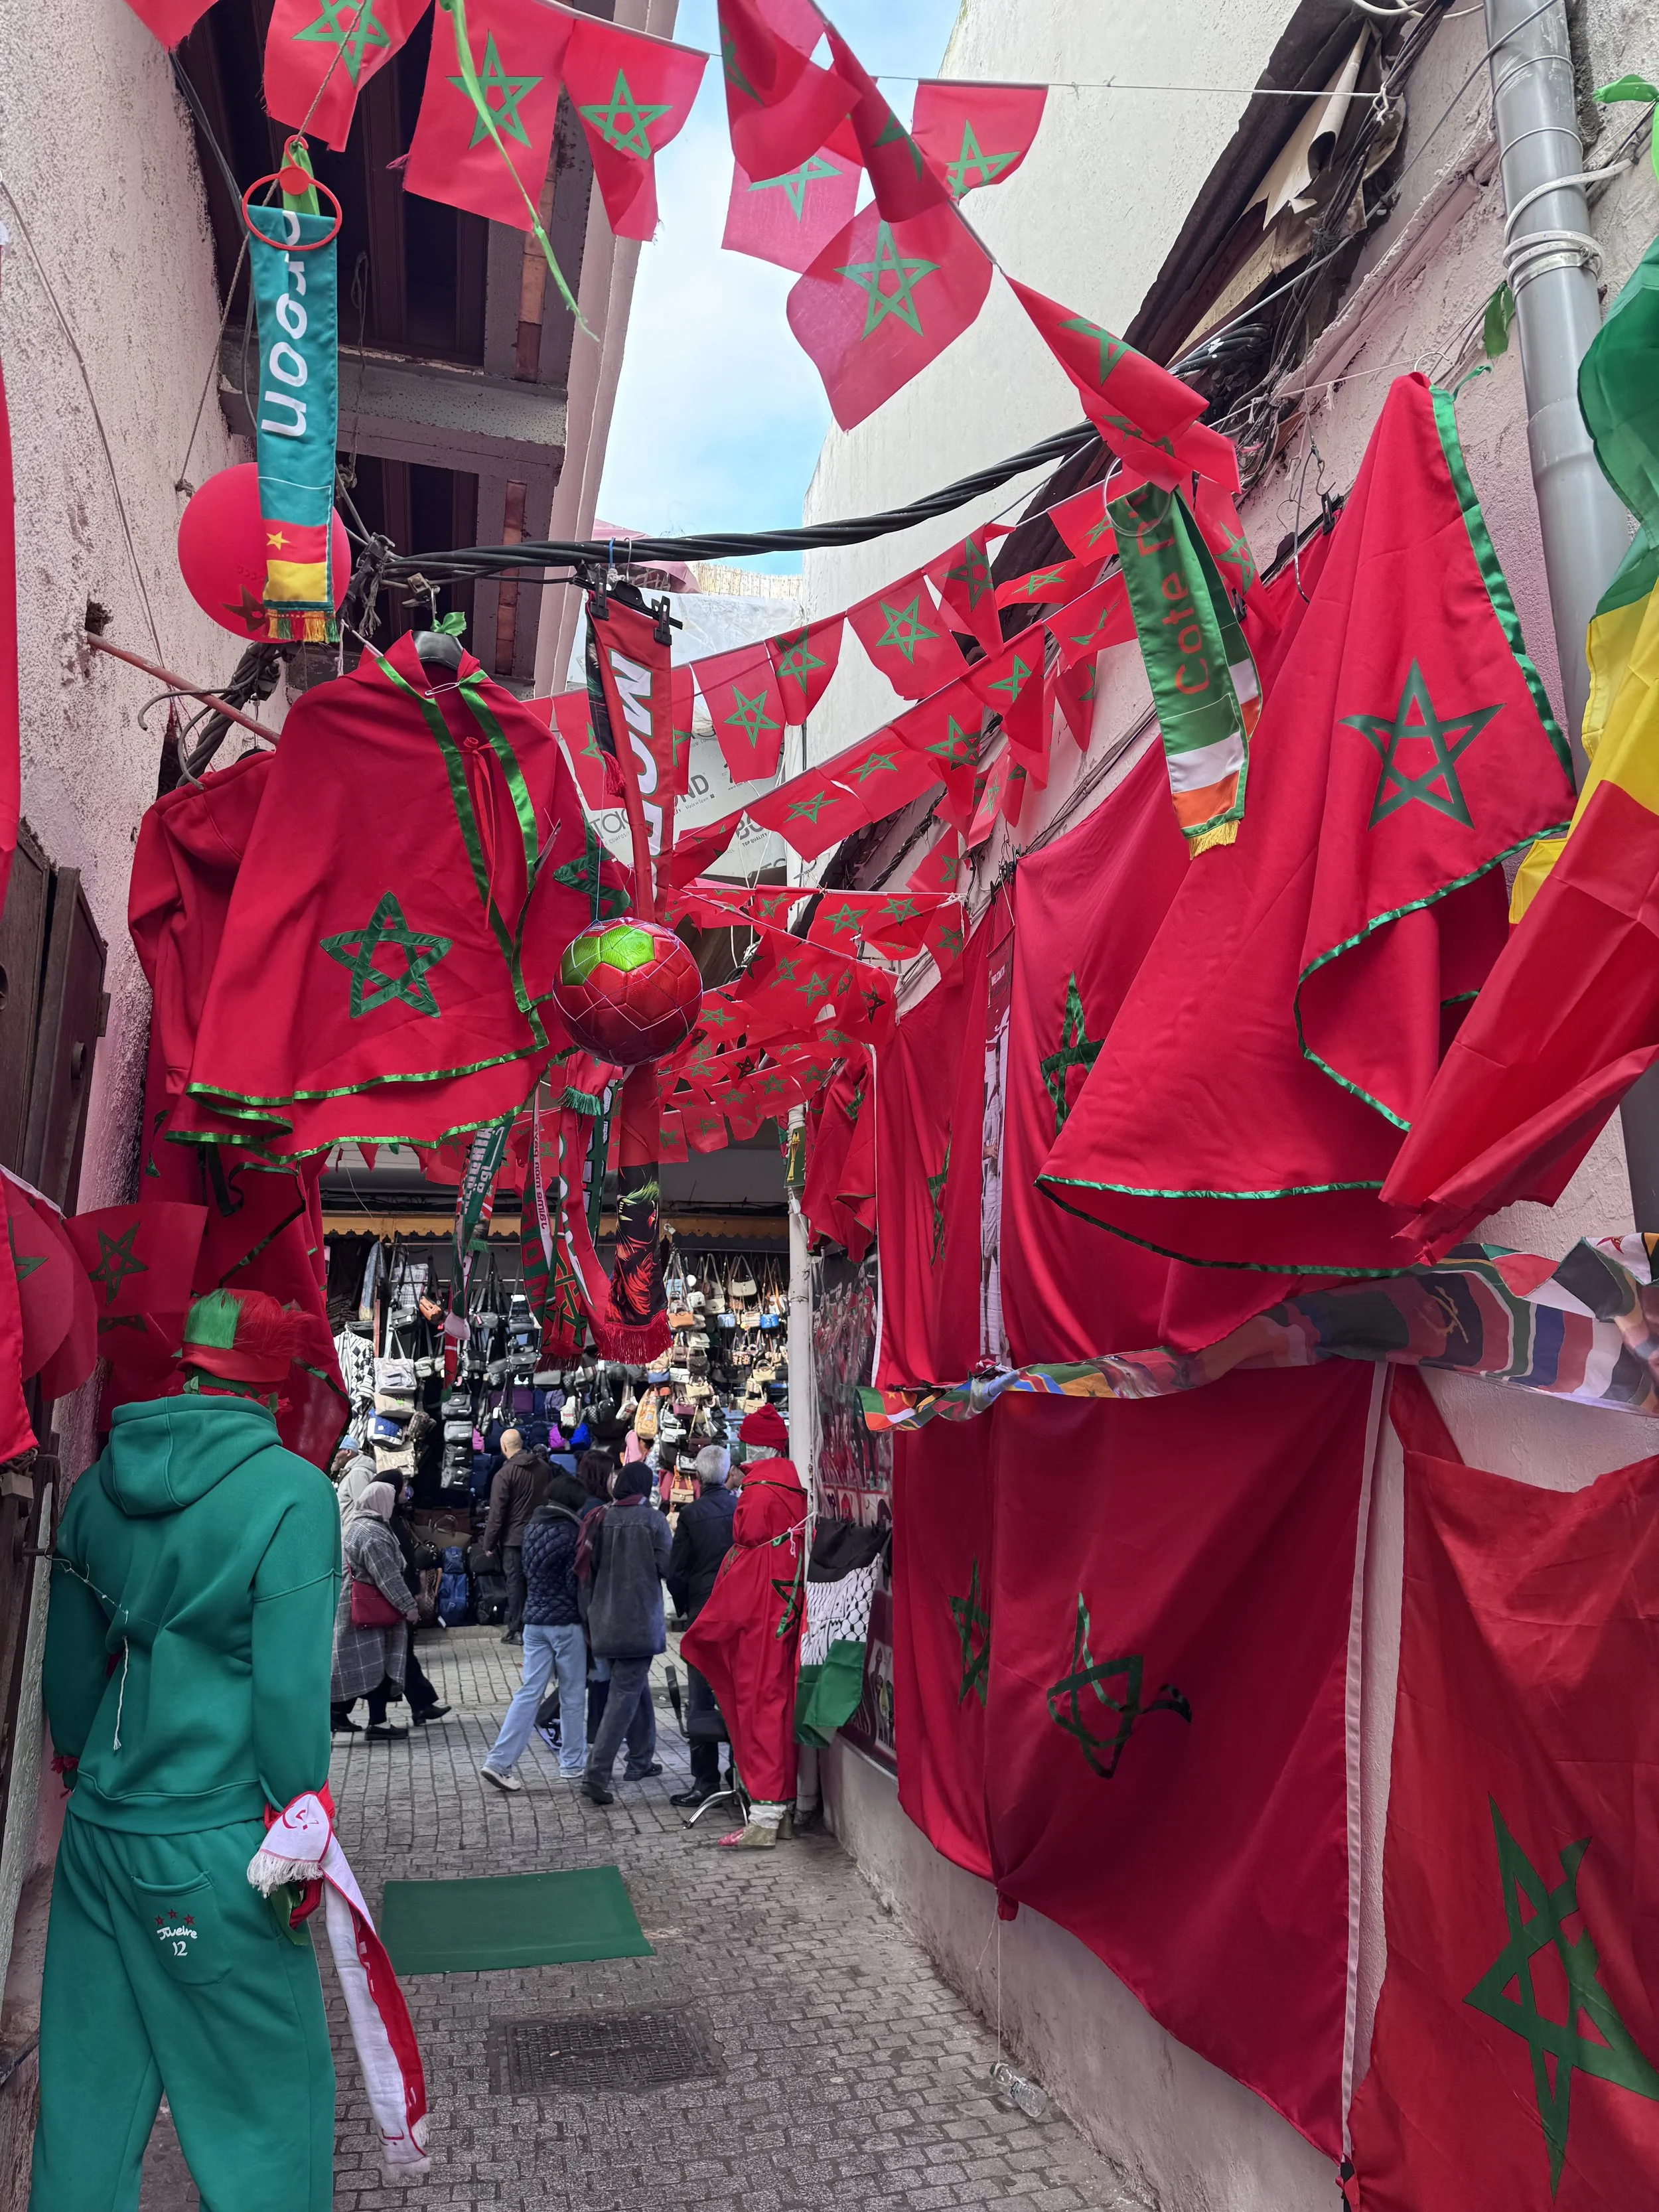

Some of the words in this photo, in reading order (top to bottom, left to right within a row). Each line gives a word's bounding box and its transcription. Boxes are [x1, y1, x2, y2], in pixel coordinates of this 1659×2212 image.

[1162, 571, 1210, 695] Cote
[609, 648, 663, 903] MOR
[674, 774, 709, 806] ND
[751, 833, 768, 845] QUALITY
[156, 1925, 198, 1941] Twelve
[172, 1941, 188, 1956] 12
